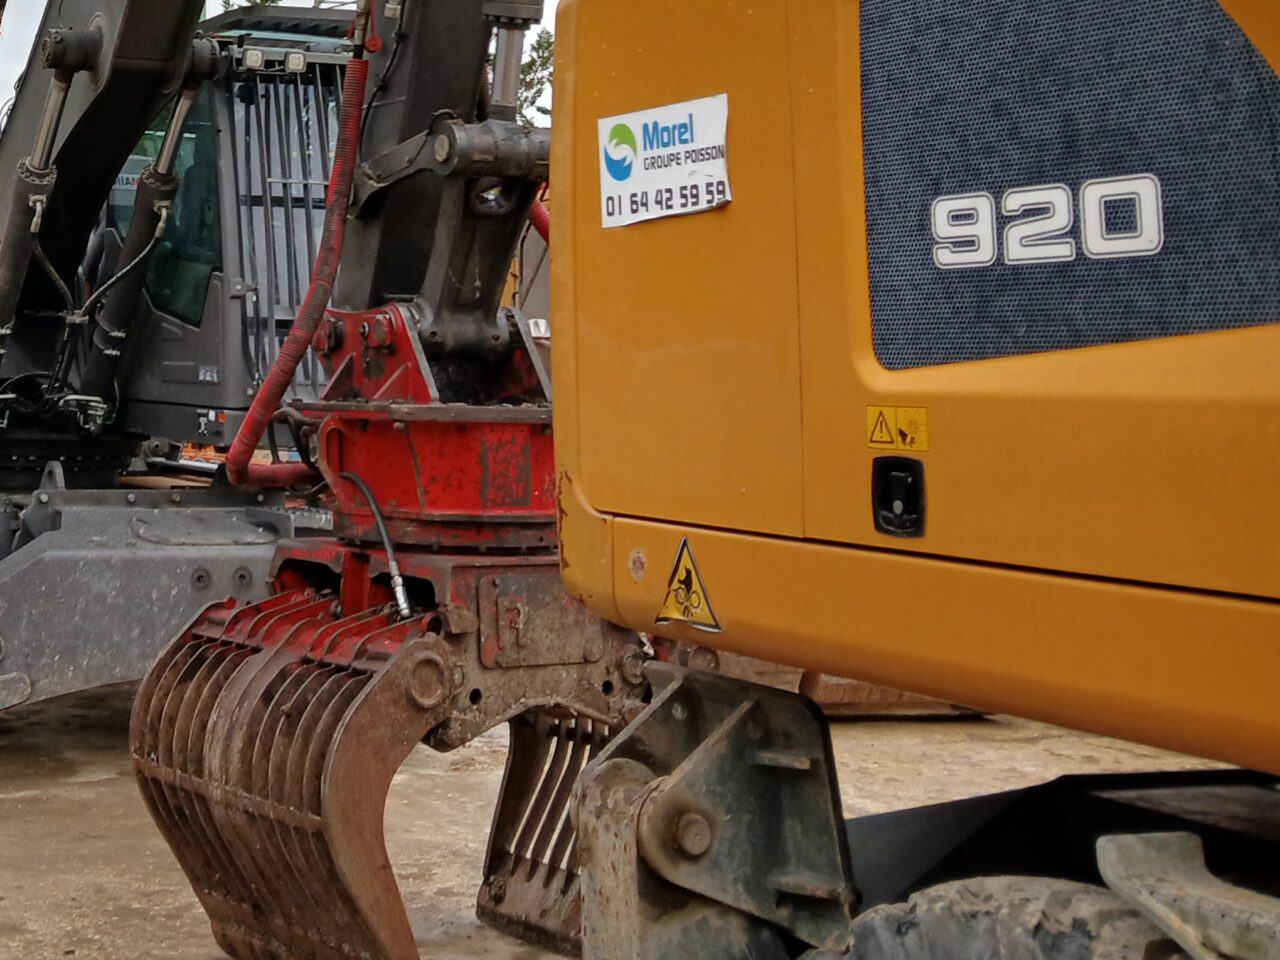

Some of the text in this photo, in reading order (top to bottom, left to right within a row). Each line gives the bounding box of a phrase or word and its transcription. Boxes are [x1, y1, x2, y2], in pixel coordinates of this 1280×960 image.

[642, 112, 694, 152] Morel
[643, 144, 725, 171] GROUPE POISSON
[606, 180, 726, 217] 01 64 42 59 59
[931, 173, 1164, 269] 920
